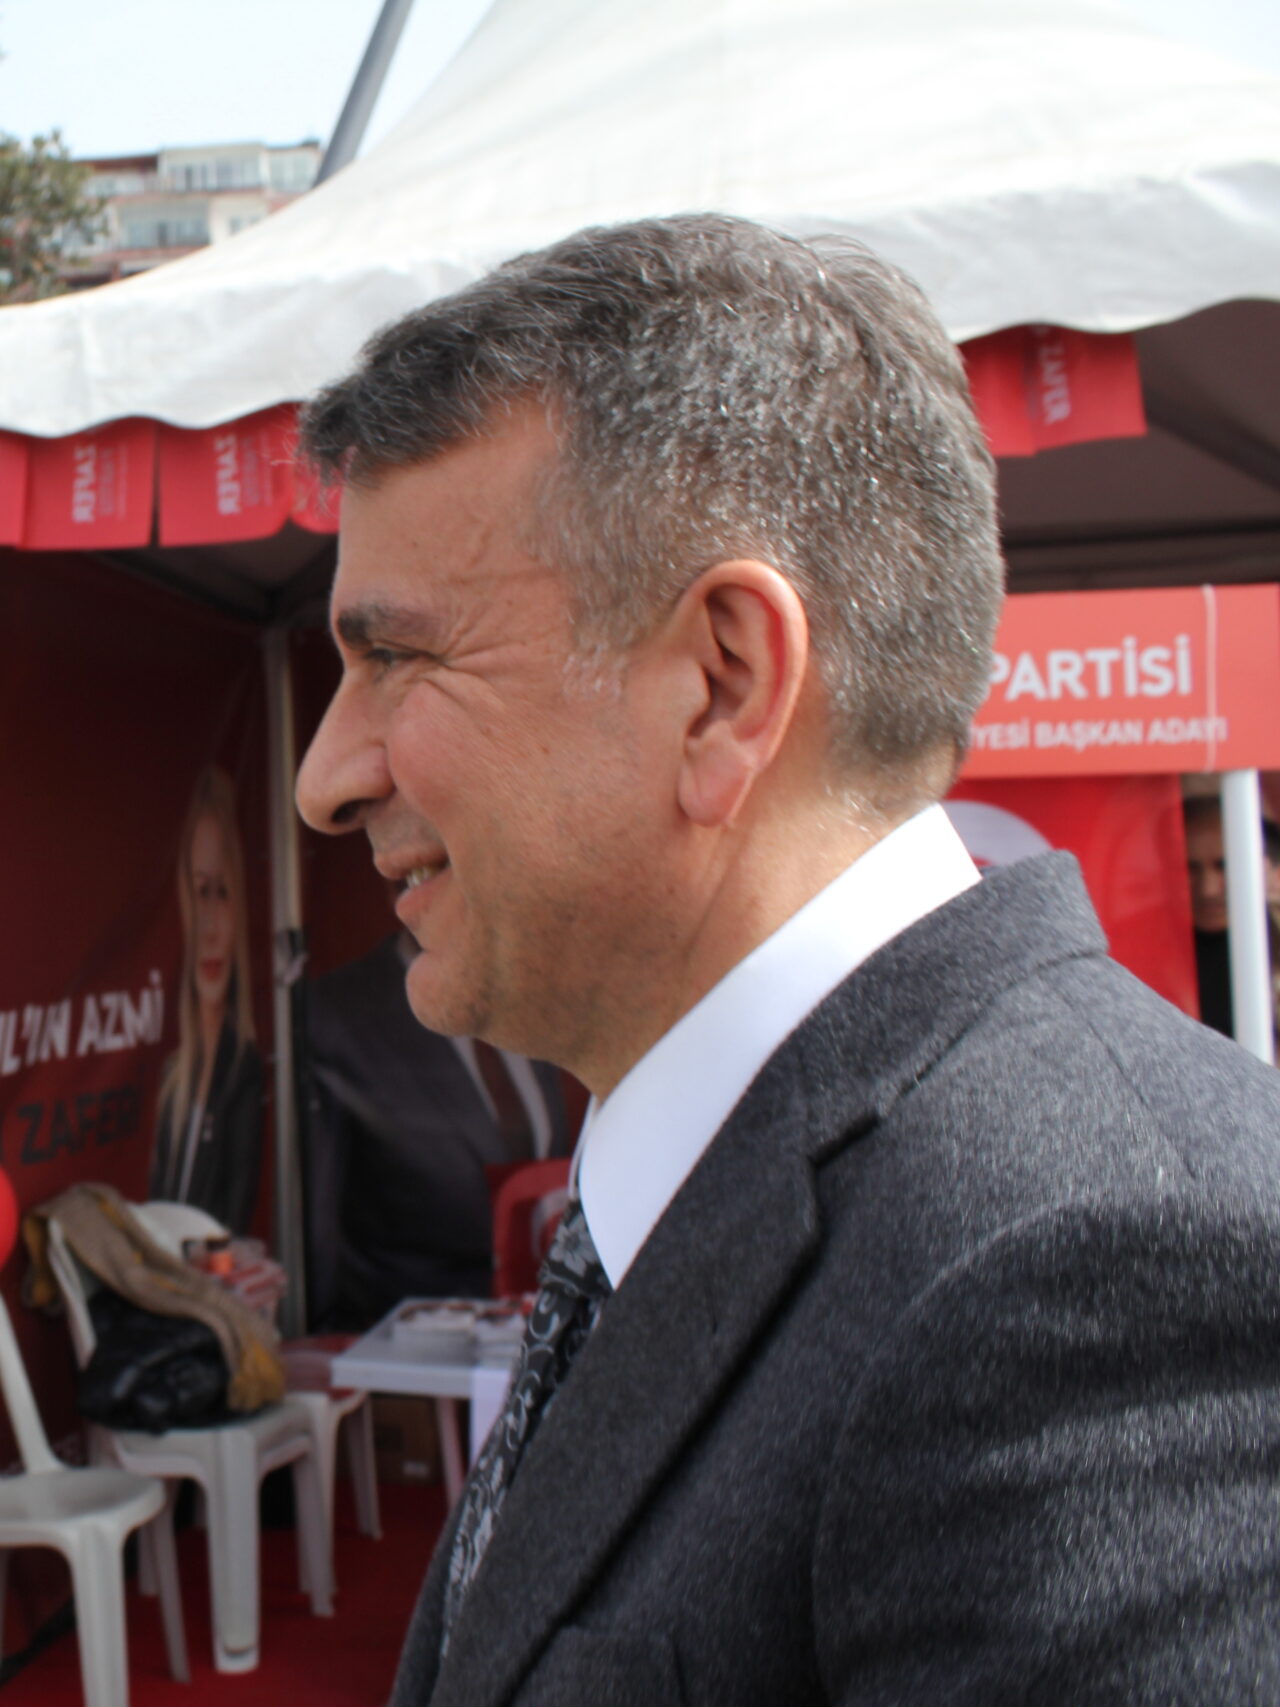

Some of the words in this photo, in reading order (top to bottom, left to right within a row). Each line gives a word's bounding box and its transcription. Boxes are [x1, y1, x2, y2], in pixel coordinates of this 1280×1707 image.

[969, 717, 1030, 749] YESİ
[1034, 719, 1144, 752] BAŞKAN
[1147, 715, 1228, 744] ADAYI
[76, 968, 165, 1057] AZMİ
